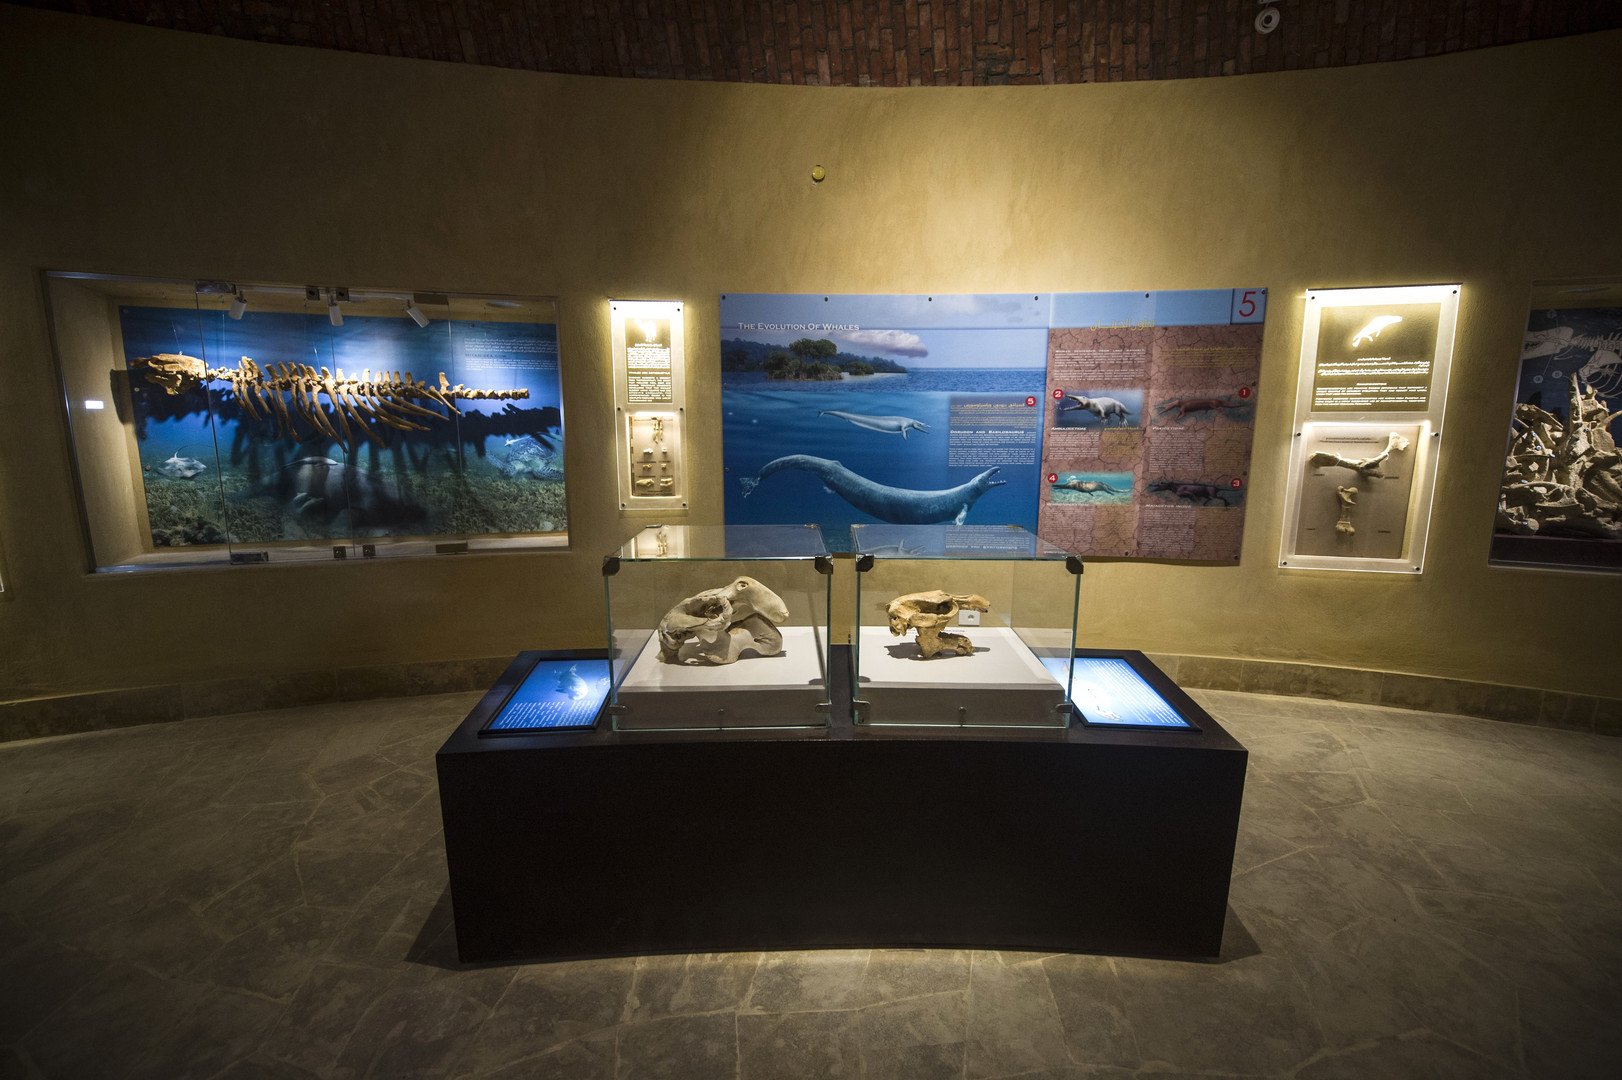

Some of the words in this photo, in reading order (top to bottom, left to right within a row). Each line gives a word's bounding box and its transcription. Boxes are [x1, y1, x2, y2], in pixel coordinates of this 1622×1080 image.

[1239, 291, 1256, 317] 5
[738, 322, 755, 330] THE
[758, 322, 805, 331] EVOLUTION
[808, 322, 819, 331] OF
[822, 323, 860, 331] WHALES
